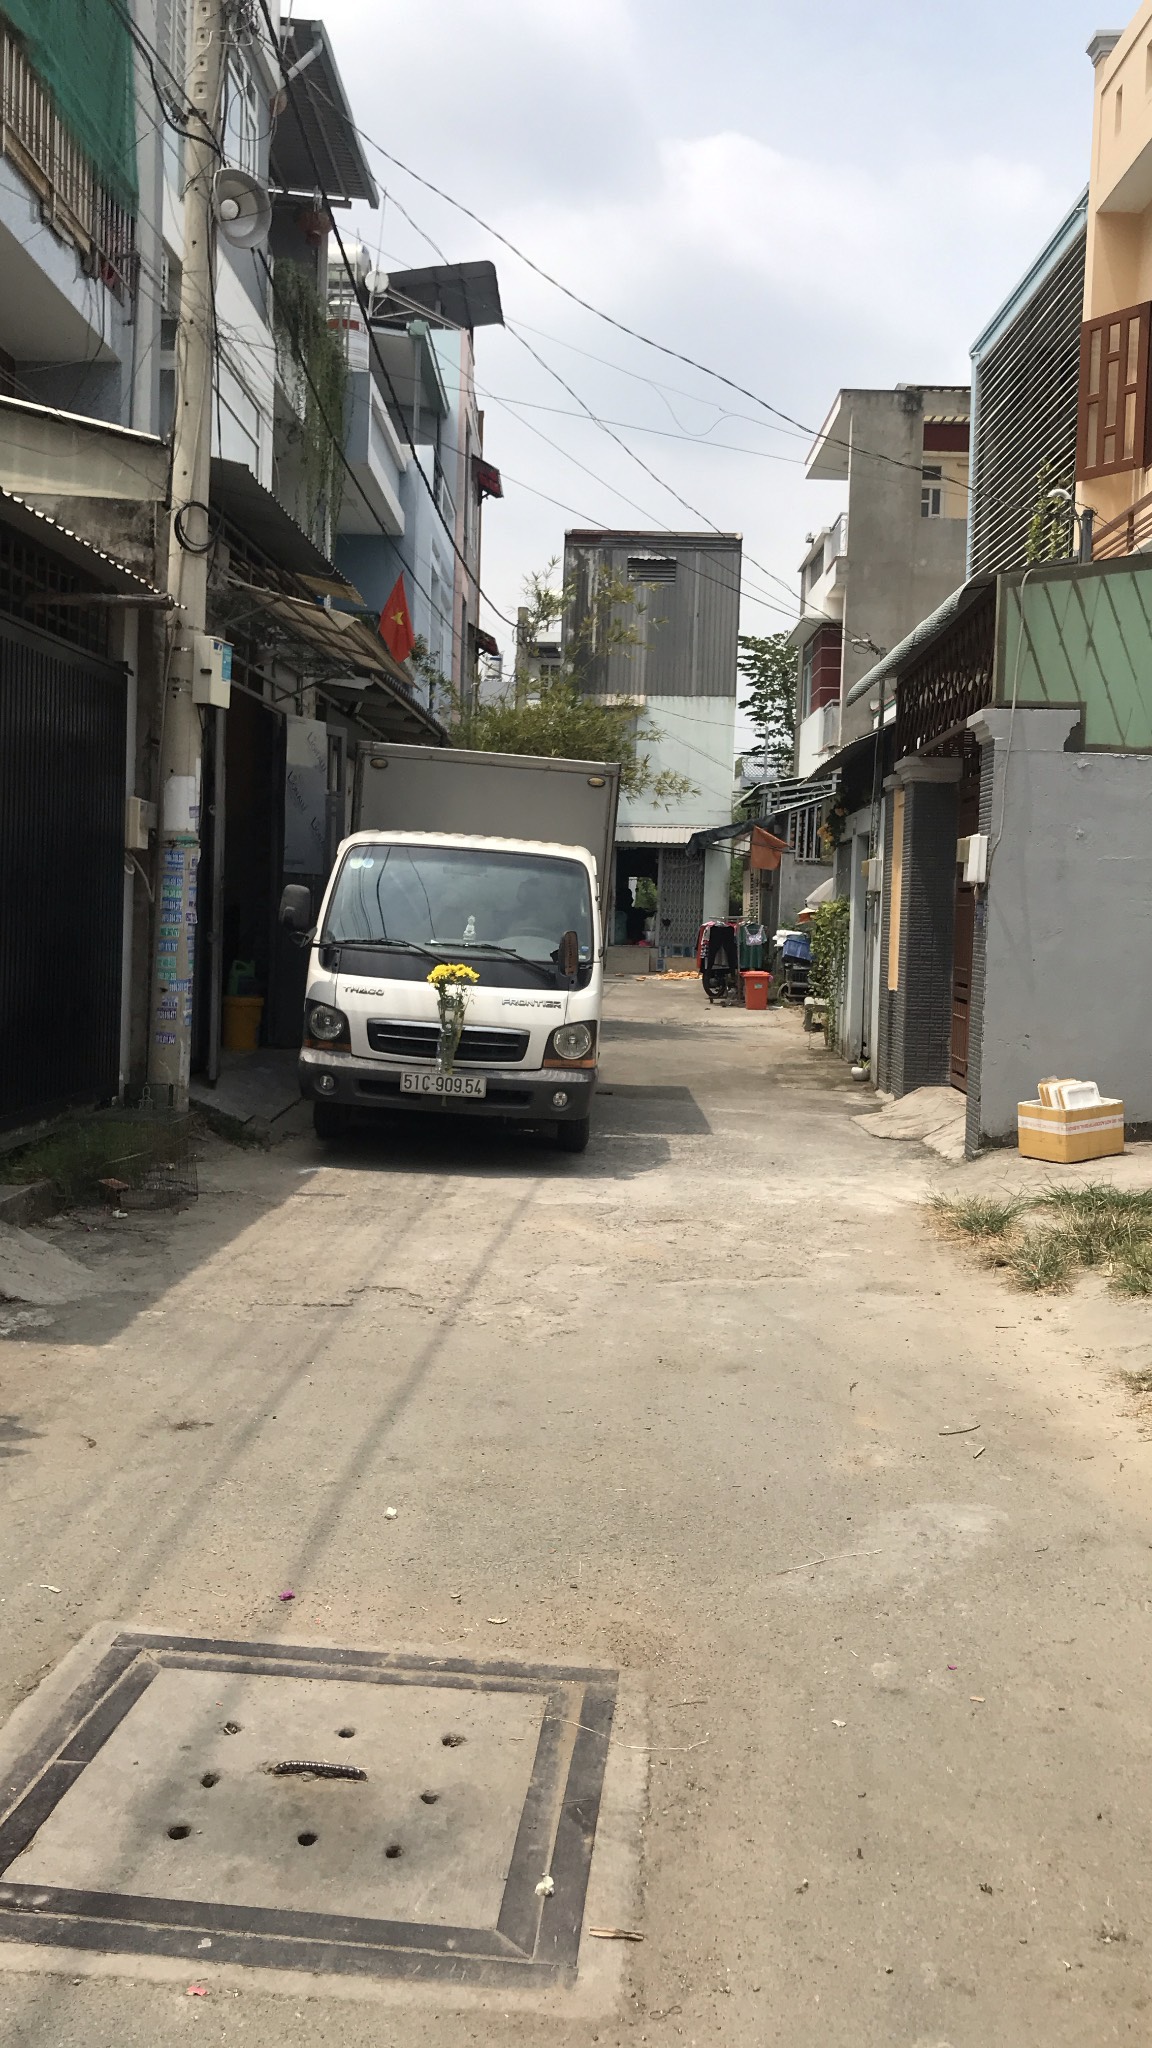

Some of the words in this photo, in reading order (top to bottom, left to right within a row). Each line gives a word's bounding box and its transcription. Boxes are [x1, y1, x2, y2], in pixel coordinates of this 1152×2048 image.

[343, 986, 385, 997] THACO
[502, 998, 562, 1009] FRONTIER
[404, 1074, 483, 1095] 51C-909.54
